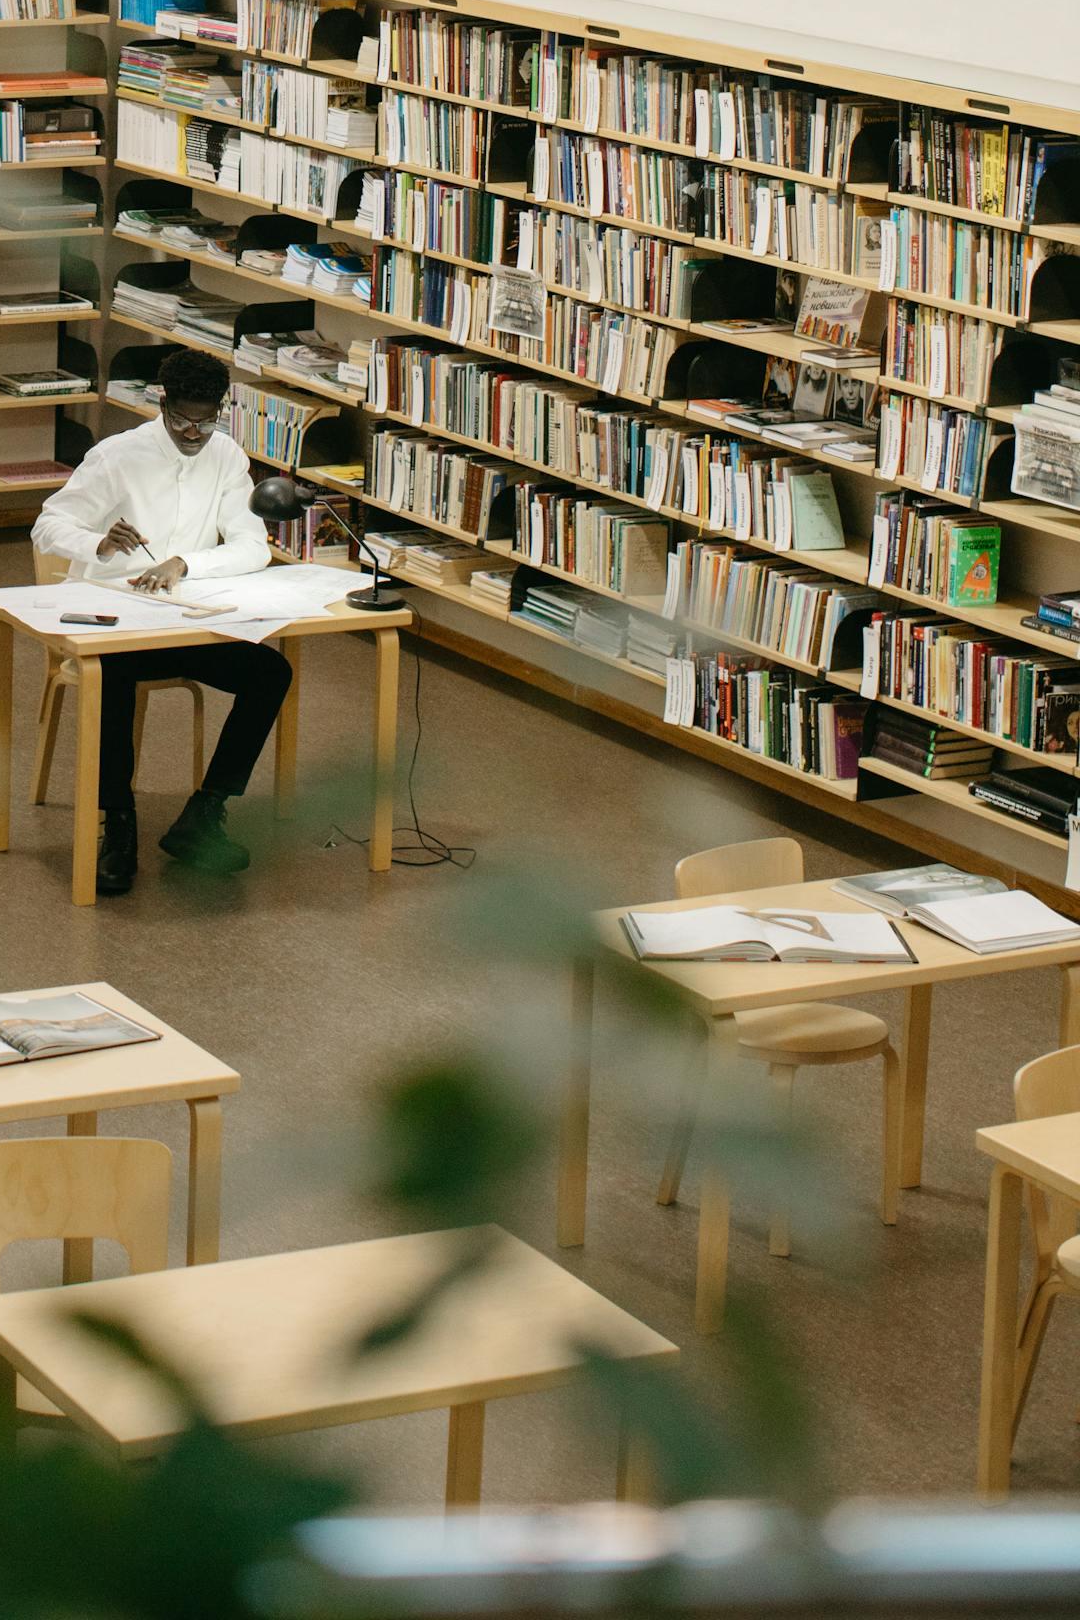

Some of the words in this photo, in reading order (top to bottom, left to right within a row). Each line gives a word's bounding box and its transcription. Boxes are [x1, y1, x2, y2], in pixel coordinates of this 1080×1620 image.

[723, 99, 729, 108] К
[811, 287, 857, 299] книжных
[809, 298, 853, 311] новинок!
